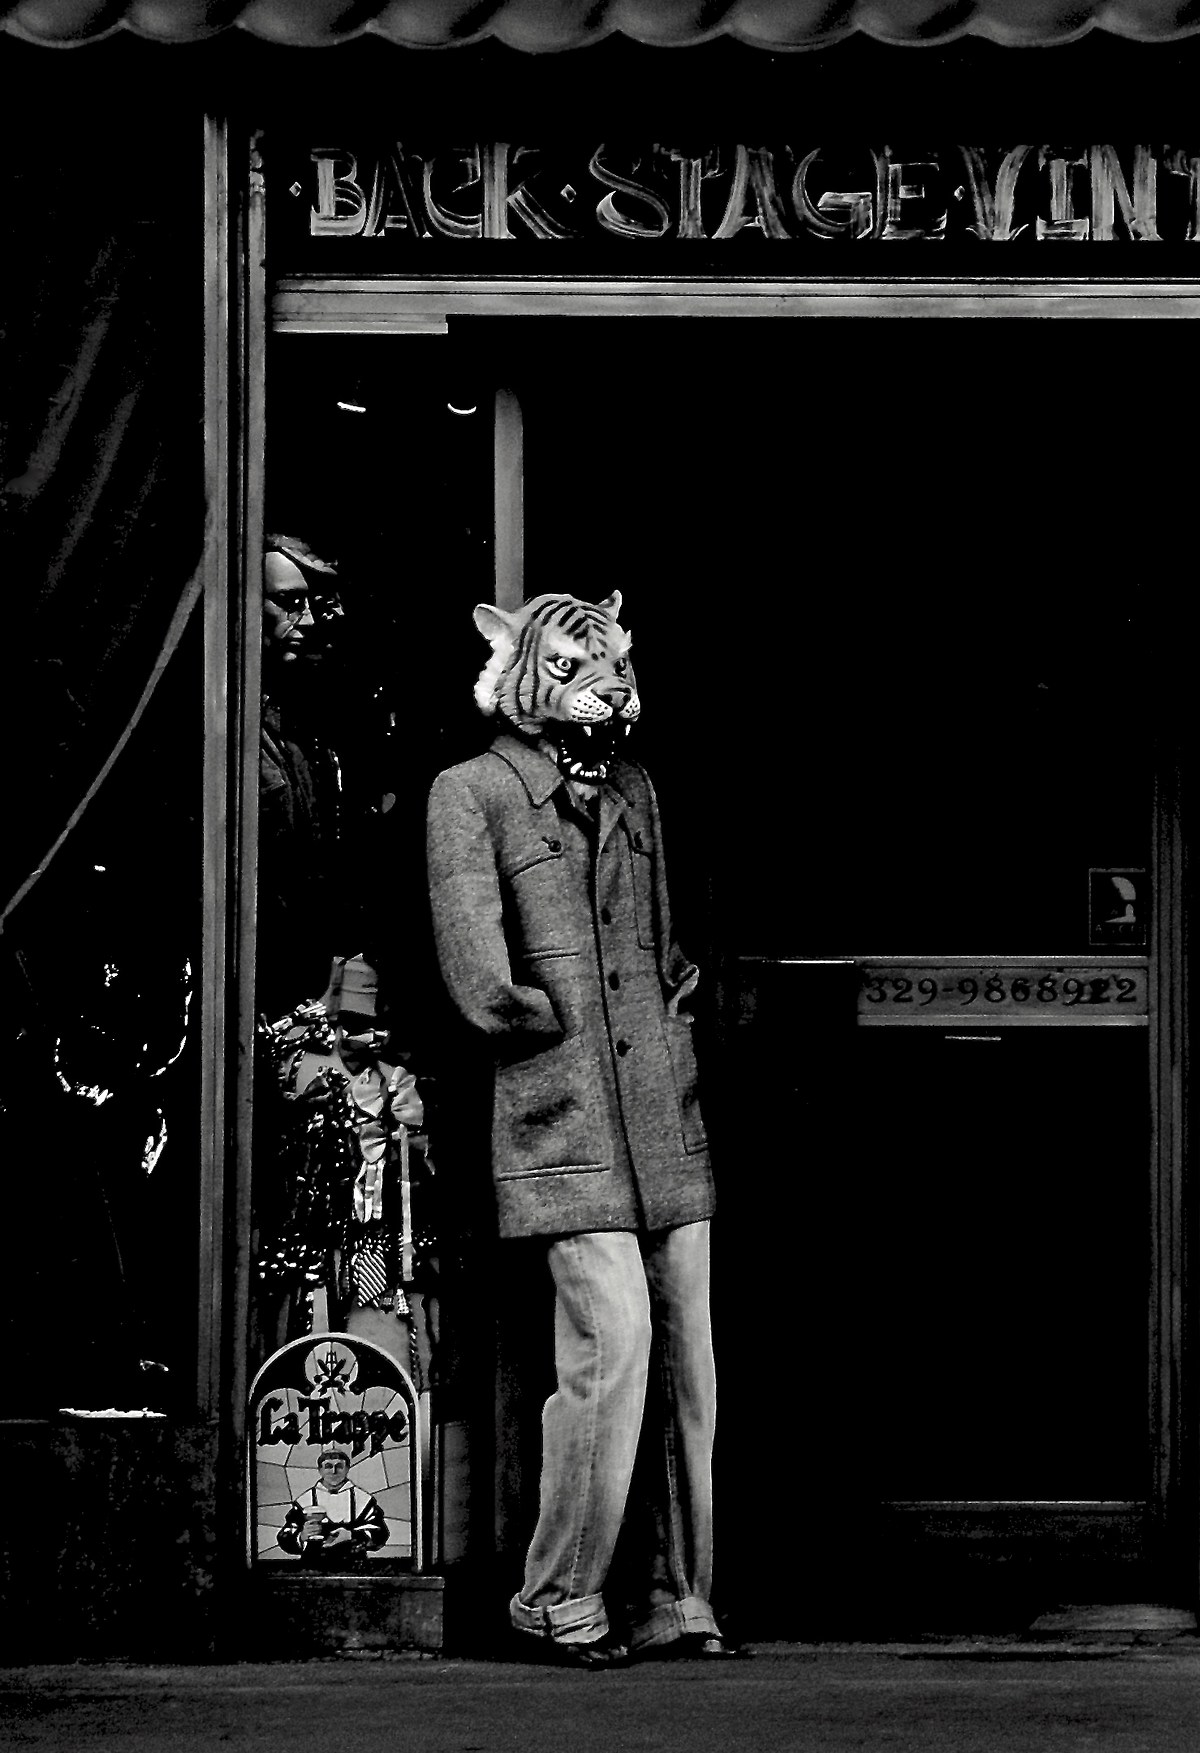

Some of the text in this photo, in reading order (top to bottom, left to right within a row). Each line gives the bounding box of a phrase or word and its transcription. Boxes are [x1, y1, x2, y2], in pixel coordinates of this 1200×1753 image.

[310, 143, 583, 239] BACK
[589, 142, 948, 239] STAGE
[259, 1398, 408, 1457] La Trappe
